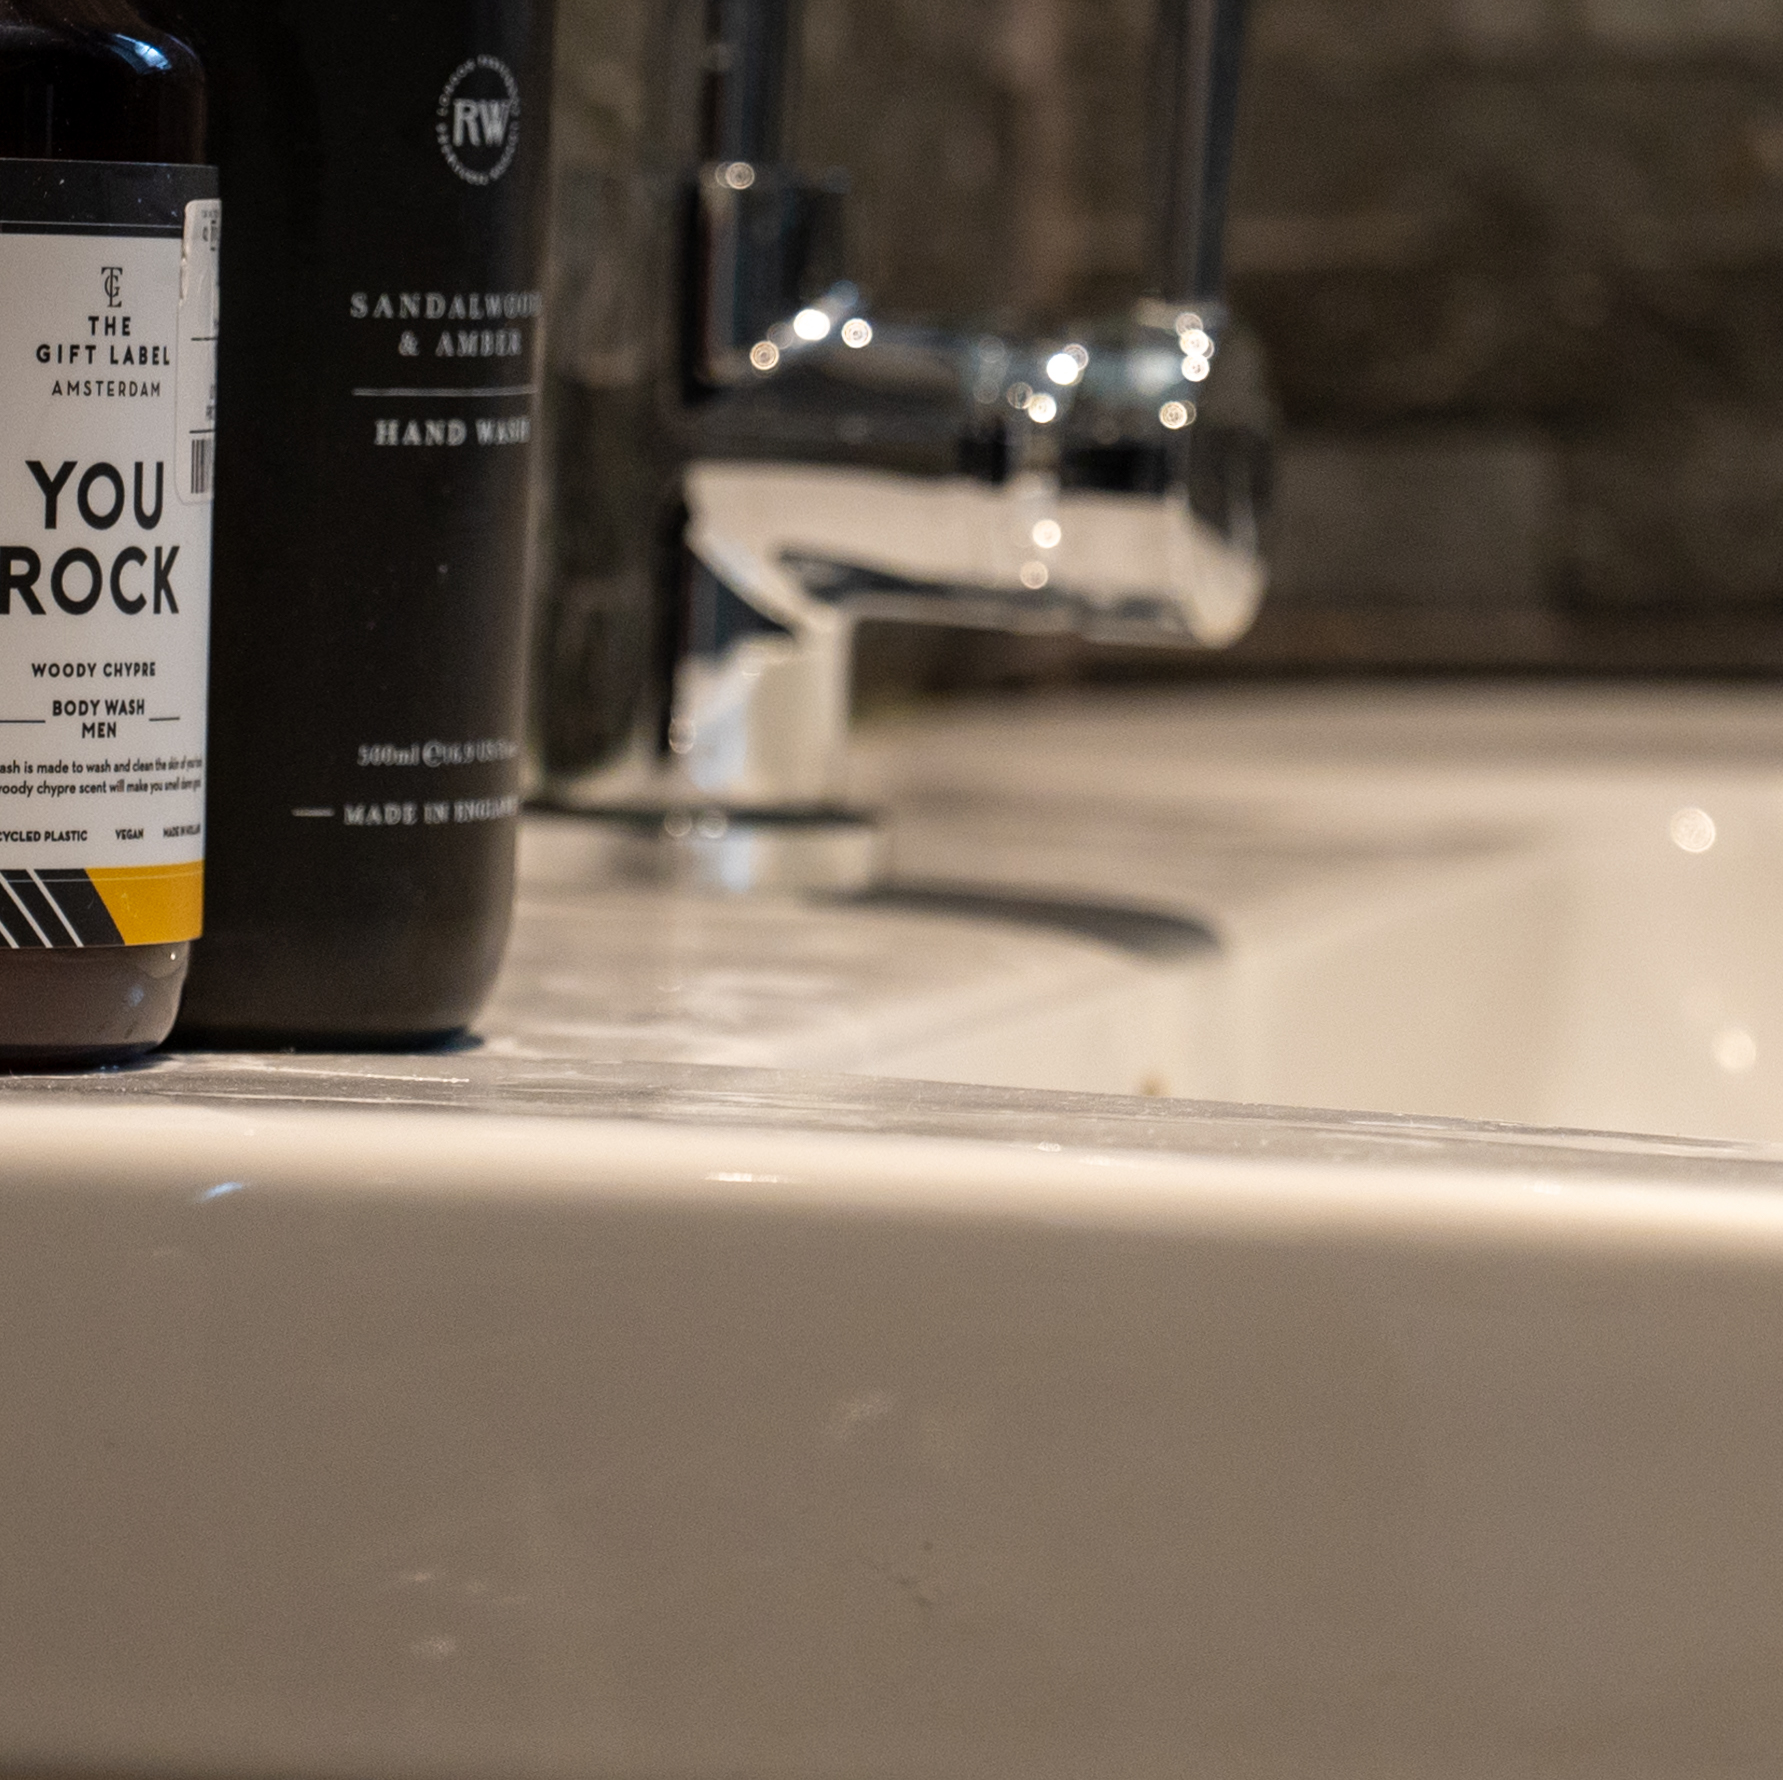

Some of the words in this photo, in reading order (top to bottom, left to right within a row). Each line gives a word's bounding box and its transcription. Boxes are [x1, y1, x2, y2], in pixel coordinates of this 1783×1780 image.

[452, 98, 512, 147] RW
[88, 315, 131, 337] THE
[398, 328, 421, 357] &
[435, 327, 523, 358] AMBER
[36, 343, 97, 365] GIFT
[110, 344, 171, 366] LABEL
[51, 379, 161, 397] AMSTERDAM
[373, 417, 469, 447] HAND
[24, 460, 165, 530] YOU
[31, 662, 97, 678] WOODY
[103, 661, 157, 678] CHYPRE
[52, 700, 101, 716] BODY
[105, 699, 145, 716] WASH
[82, 722, 117, 739] MEN
[24, 761, 33, 774] is
[37, 760, 69, 774] made
[72, 761, 83, 774] to
[86, 759, 111, 773] wash
[114, 758, 131, 772] and
[132, 758, 154, 772] clean
[155, 757, 166, 771] the
[37, 780, 76, 798] chypre
[79, 780, 107, 794] scent
[109, 778, 125, 794] will
[126, 778, 149, 793] make
[150, 783, 164, 795] you
[343, 802, 418, 826] MADE
[423, 801, 450, 825] IN
[44, 829, 88, 842] PLASTIC
[115, 828, 144, 840] VEGAN
